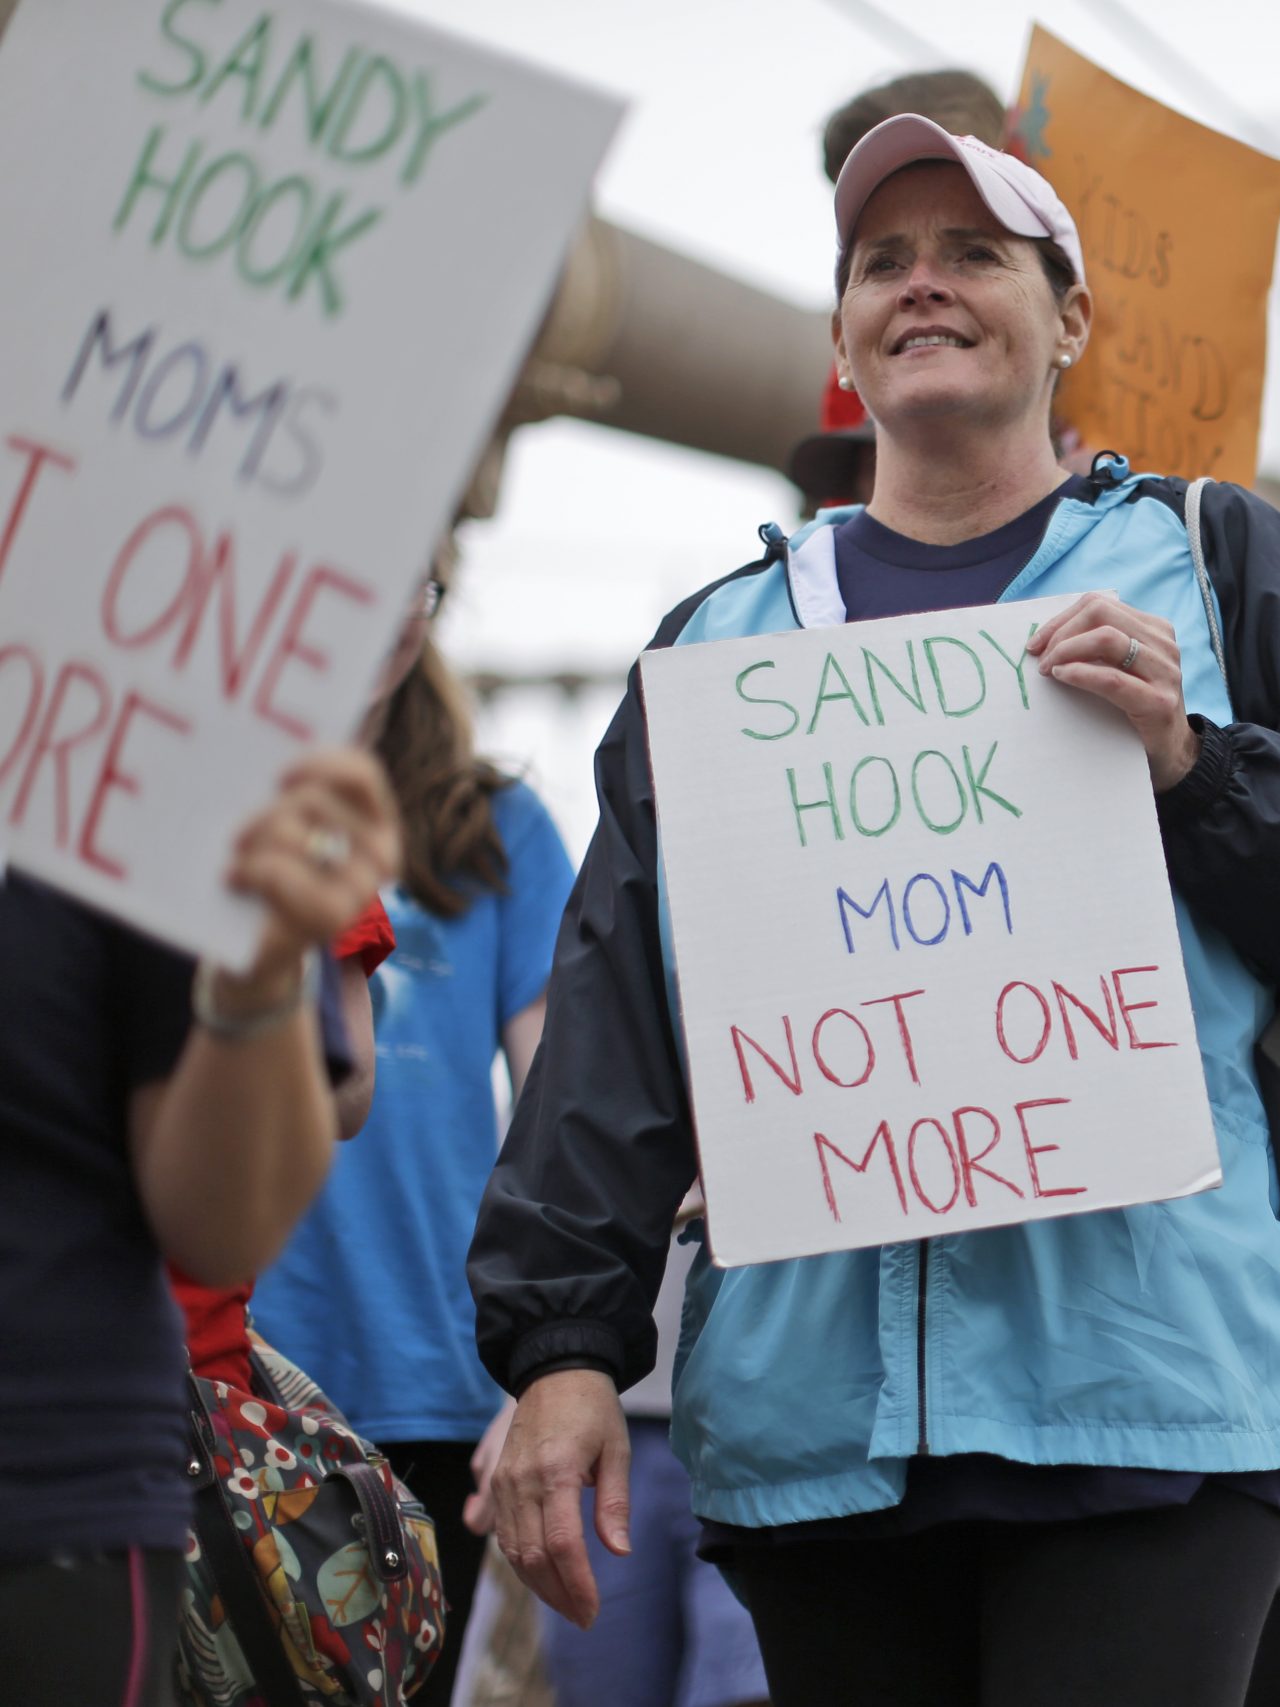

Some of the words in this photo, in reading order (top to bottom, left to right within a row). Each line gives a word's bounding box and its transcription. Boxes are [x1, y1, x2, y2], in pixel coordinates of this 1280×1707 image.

[135, 0, 489, 188] SANDY
[112, 123, 385, 320] HOOK
[60, 306, 340, 498] MOMS
[101, 504, 378, 745] ONE
[735, 623, 1038, 741] SANDY
[786, 741, 1022, 846] HOOK
[836, 861, 1013, 954] MOM
[731, 989, 925, 1103] NOT
[996, 965, 1178, 1064] ONE
[814, 1097, 1088, 1222] MORE
